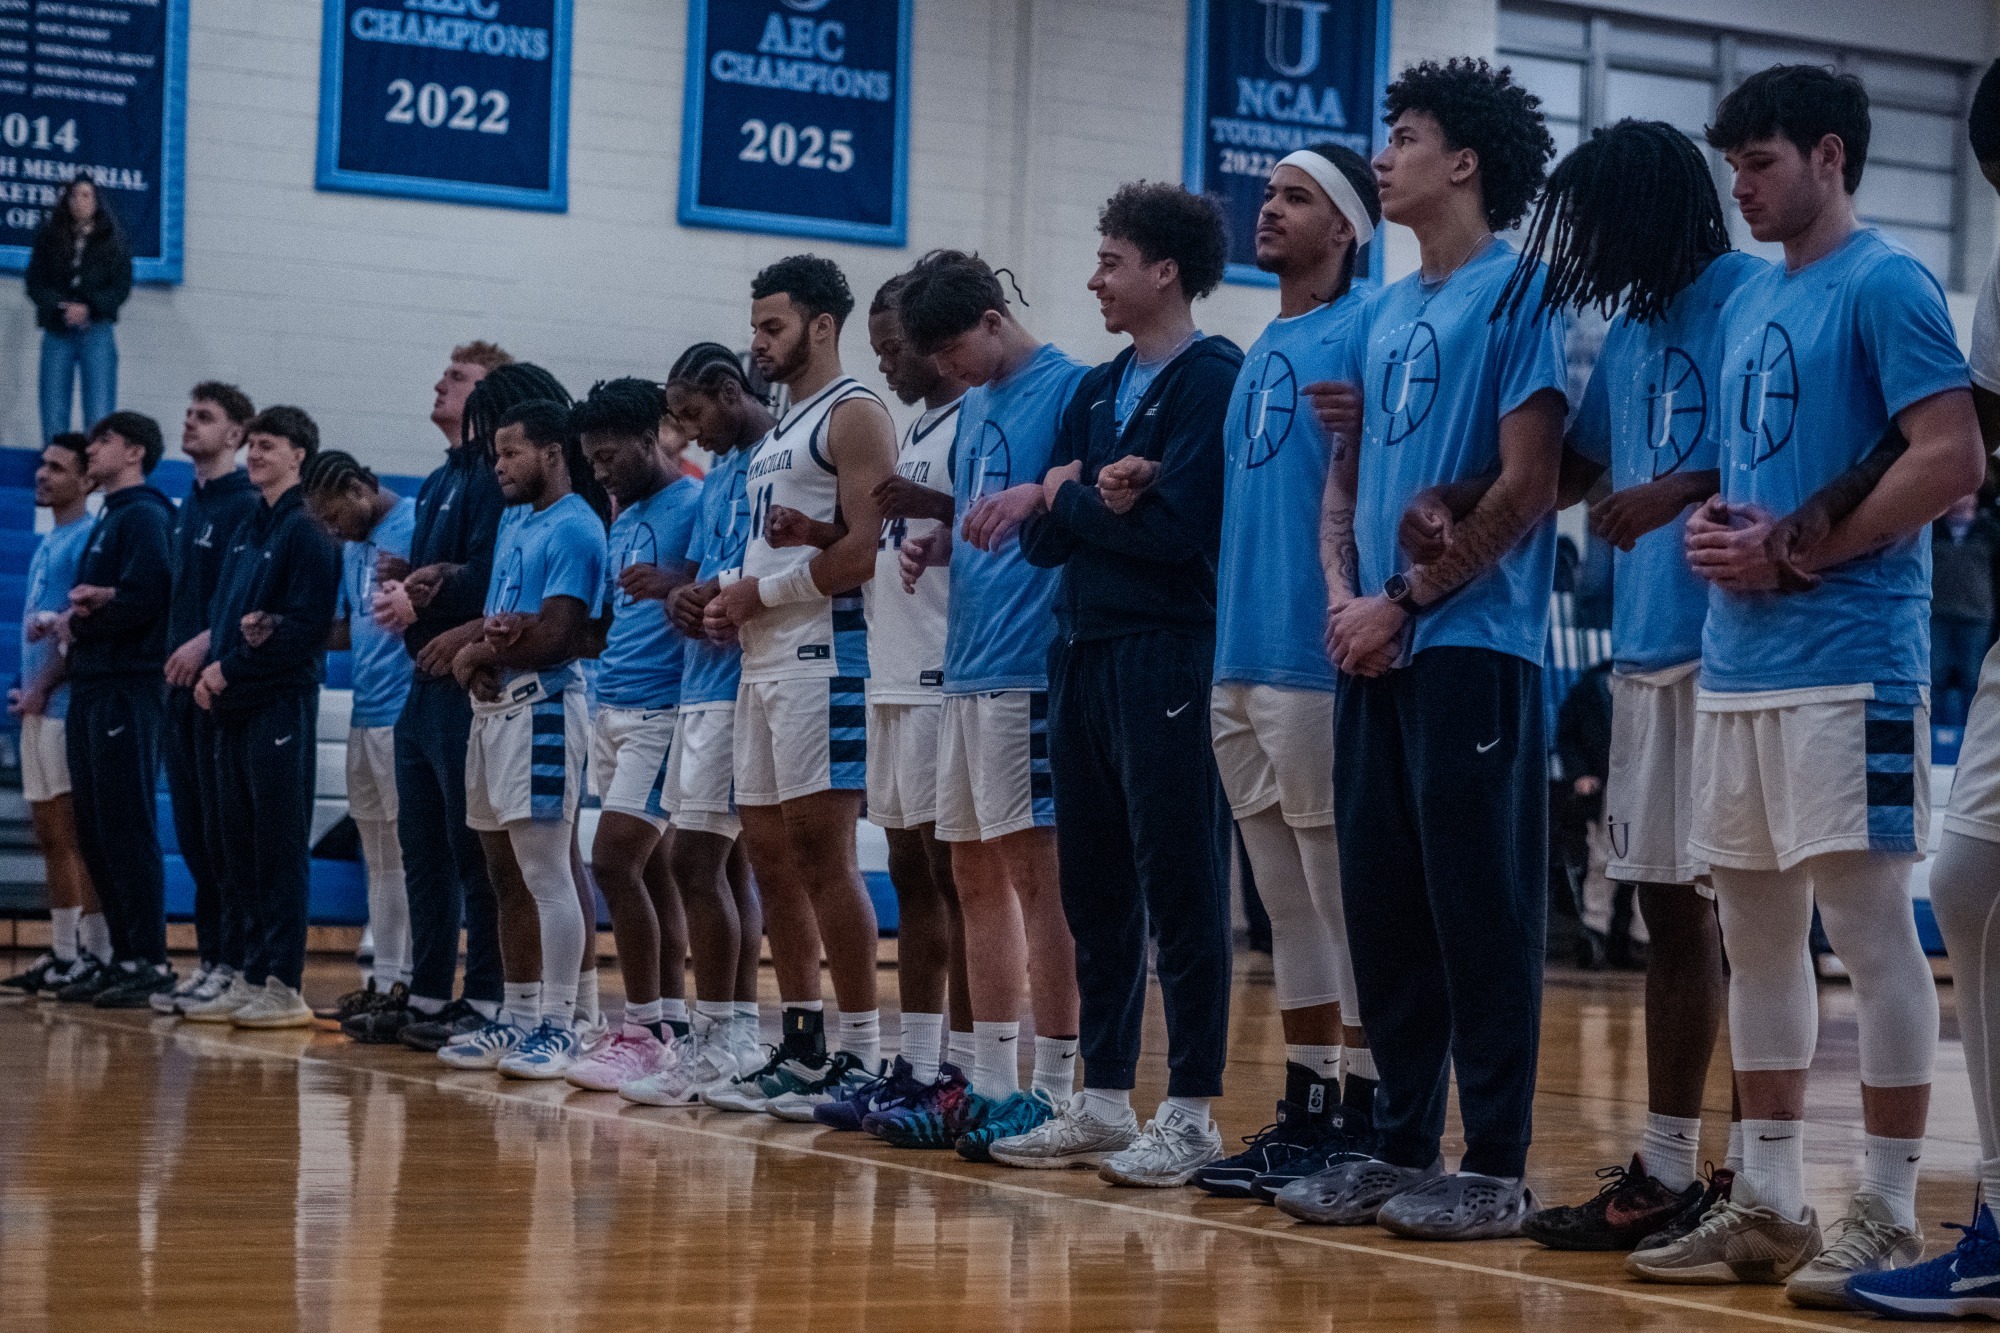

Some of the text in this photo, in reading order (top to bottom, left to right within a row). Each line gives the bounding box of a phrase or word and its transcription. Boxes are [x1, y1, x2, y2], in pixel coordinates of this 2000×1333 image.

[351, 6, 549, 61] CHAMPIONS
[756, 11, 847, 62] AEC
[710, 50, 892, 102] CHAMPIONS
[1237, 76, 1347, 128] NCAA
[0, 112, 79, 153] 014
[384, 78, 510, 135] 2022
[738, 118, 855, 173] 2025
